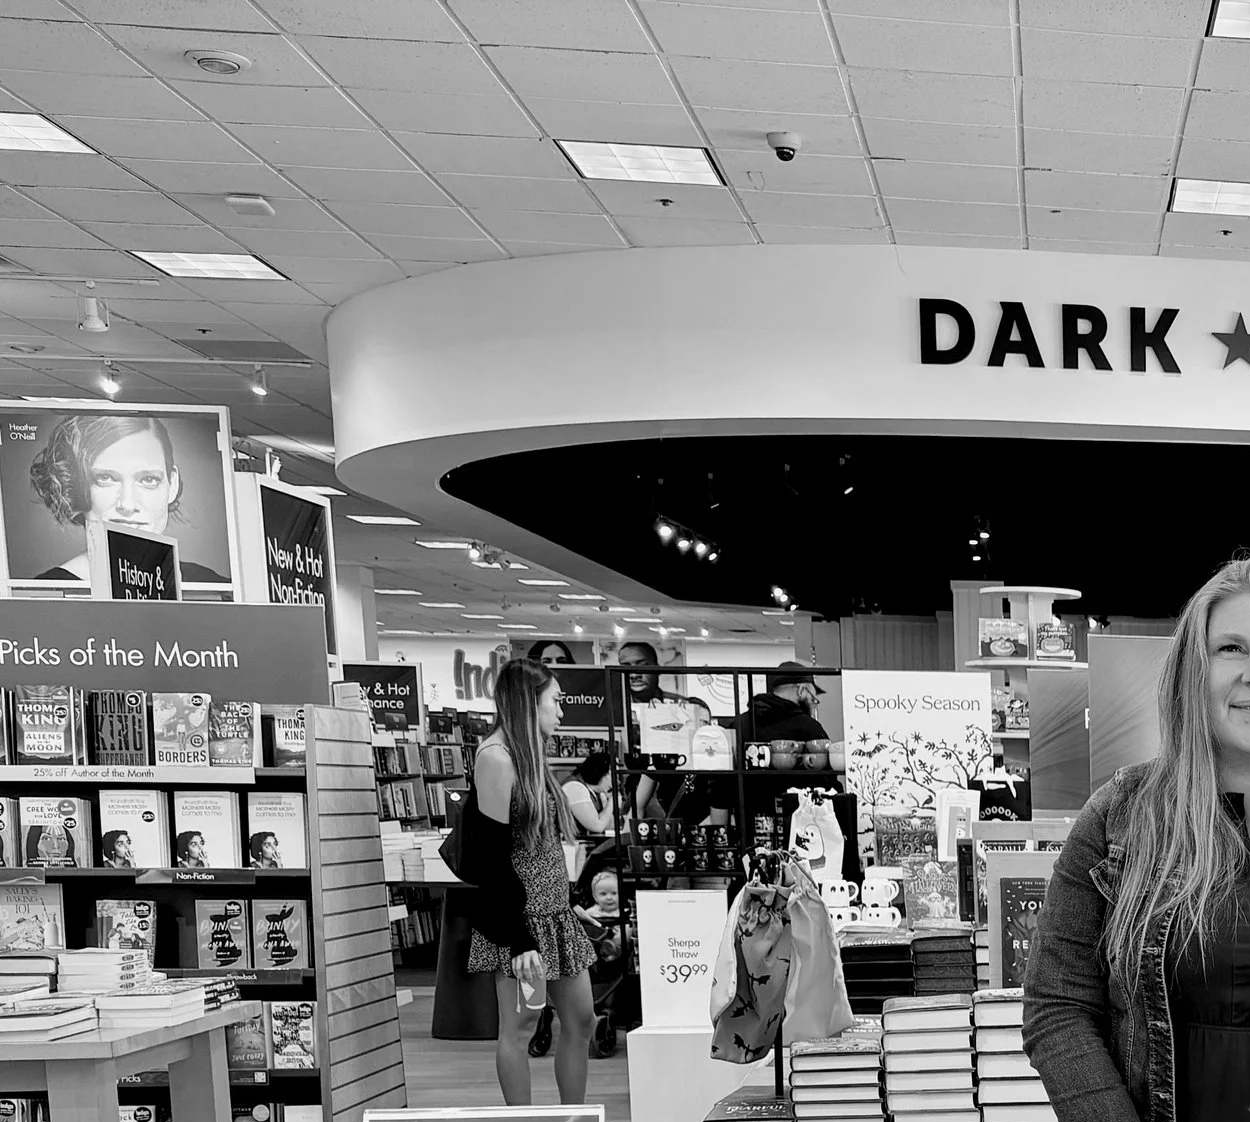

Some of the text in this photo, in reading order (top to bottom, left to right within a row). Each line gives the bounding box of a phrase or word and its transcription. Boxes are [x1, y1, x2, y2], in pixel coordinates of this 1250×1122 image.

[918, 297, 1181, 373] DARK
[9, 423, 37, 433] Heather
[267, 537, 323, 579] New & Hot
[118, 558, 165, 593] History &
[271, 575, 325, 604] Non-Fiction
[0, 638, 239, 669] Picks of the Month
[374, 683, 410, 696] & Hot
[560, 692, 605, 708] Fantasy
[853, 693, 981, 714] Spooky Season
[158, 750, 207, 763] BORDERS
[33, 768, 155, 778] 25% off Author of the Month
[176, 872, 215, 881] Non-Fiction
[668, 937, 700, 950] Sherpa
[671, 949, 698, 959] Throw
